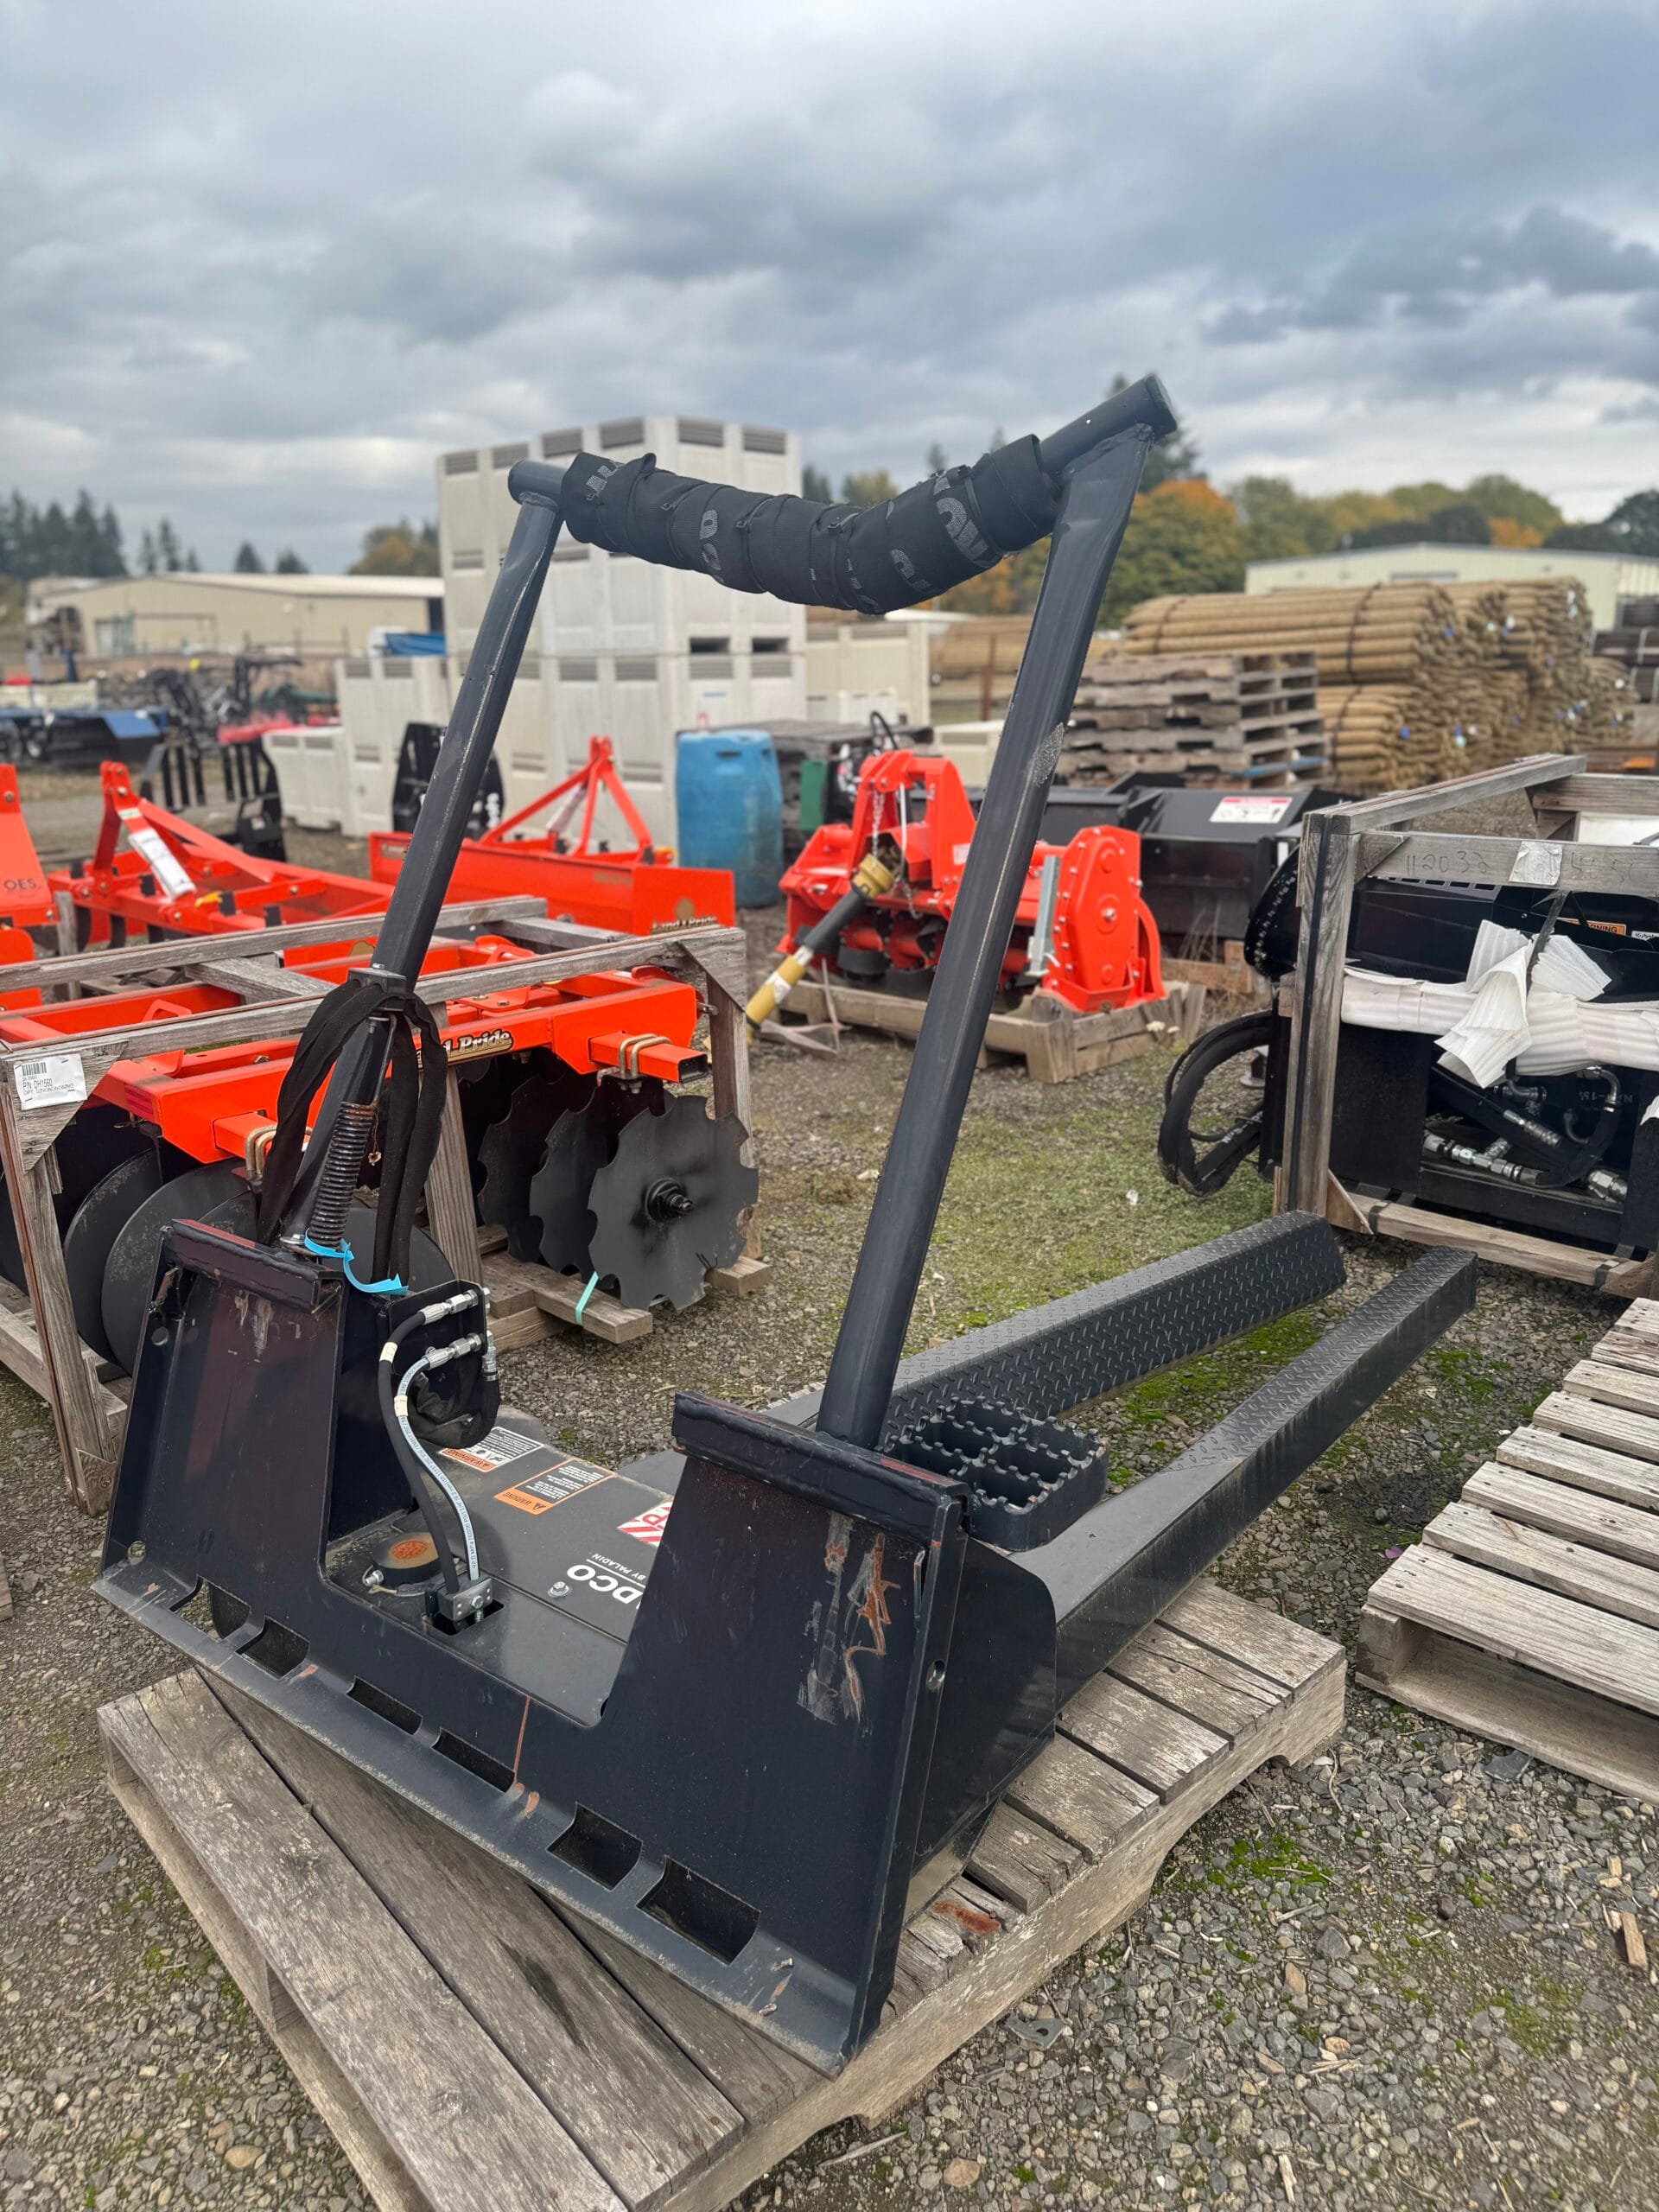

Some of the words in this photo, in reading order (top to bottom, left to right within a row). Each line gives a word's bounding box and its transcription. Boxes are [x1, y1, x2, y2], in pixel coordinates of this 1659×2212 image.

[458, 1030, 512, 1053] Pride
[448, 1449, 483, 1466] WARNING
[503, 1491, 531, 1506] WARNING
[592, 1553, 632, 1575] PALADIN
[631, 1569, 646, 1580] BY
[567, 1564, 646, 1610] DCO
